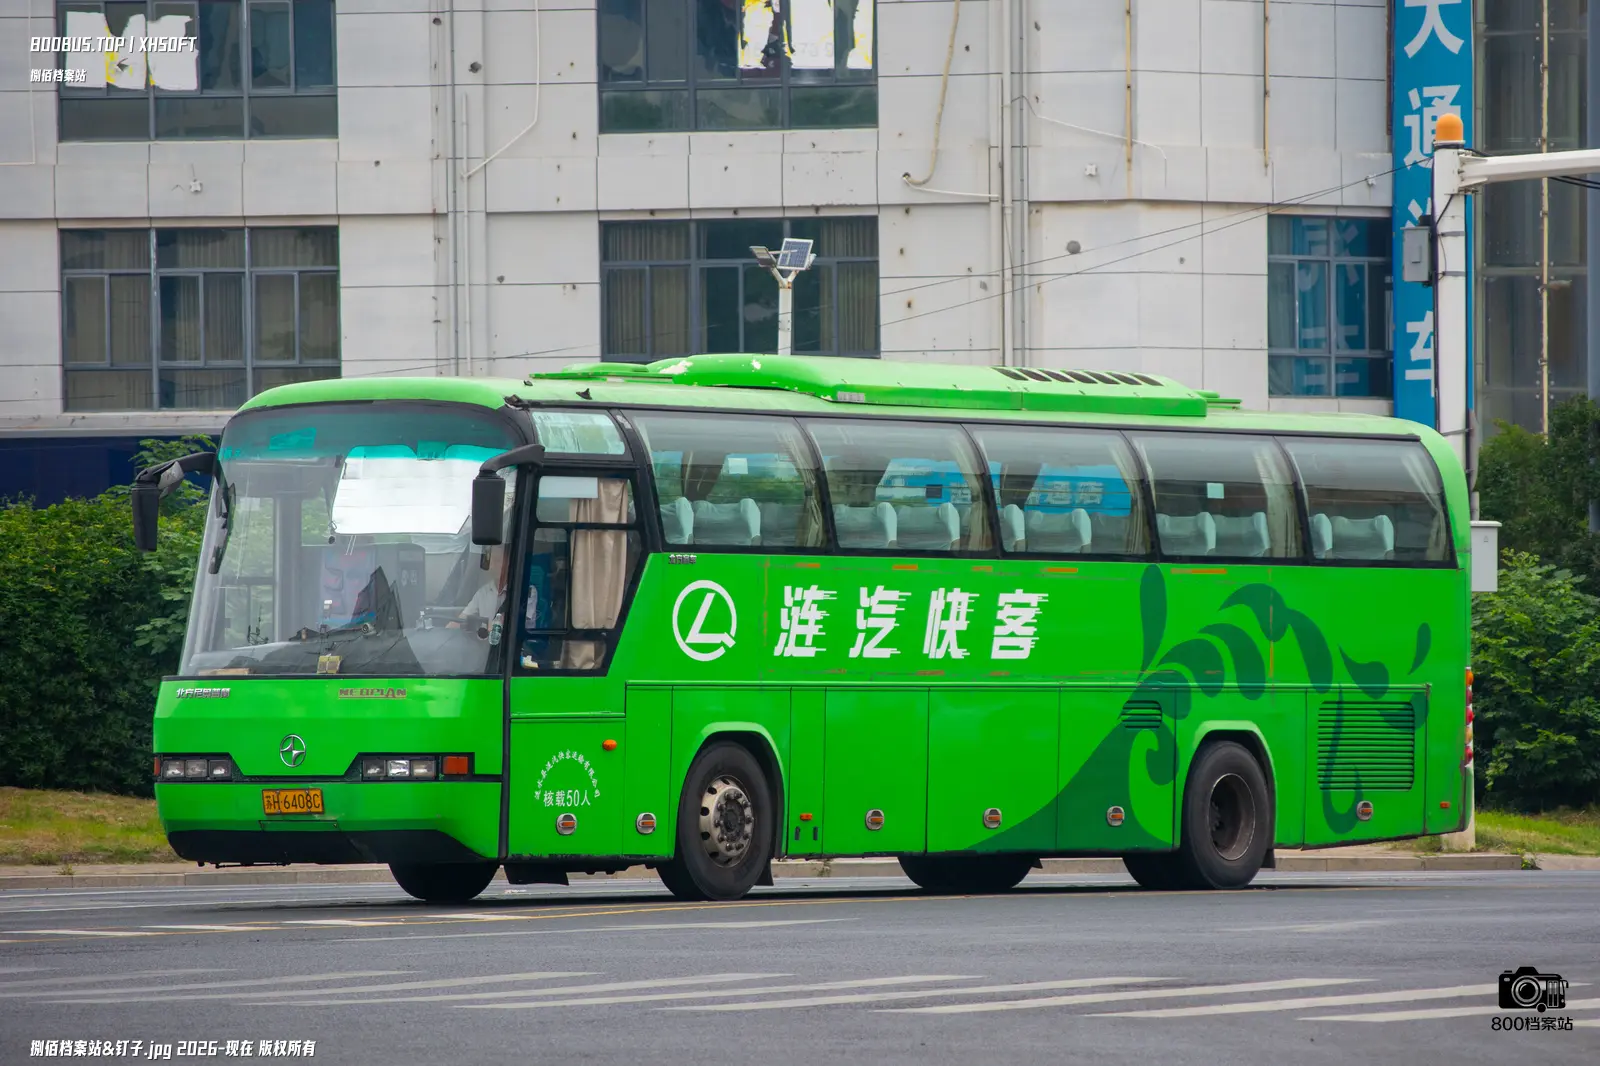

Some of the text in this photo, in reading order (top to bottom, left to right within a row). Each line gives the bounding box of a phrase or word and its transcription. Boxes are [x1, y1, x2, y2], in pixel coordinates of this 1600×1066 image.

[1403, 0, 1464, 398] 大通车
[774, 585, 1049, 660] 涟汽快客
[339, 687, 407, 699] NEOPLAN
[543, 789, 591, 807] 核载50人
